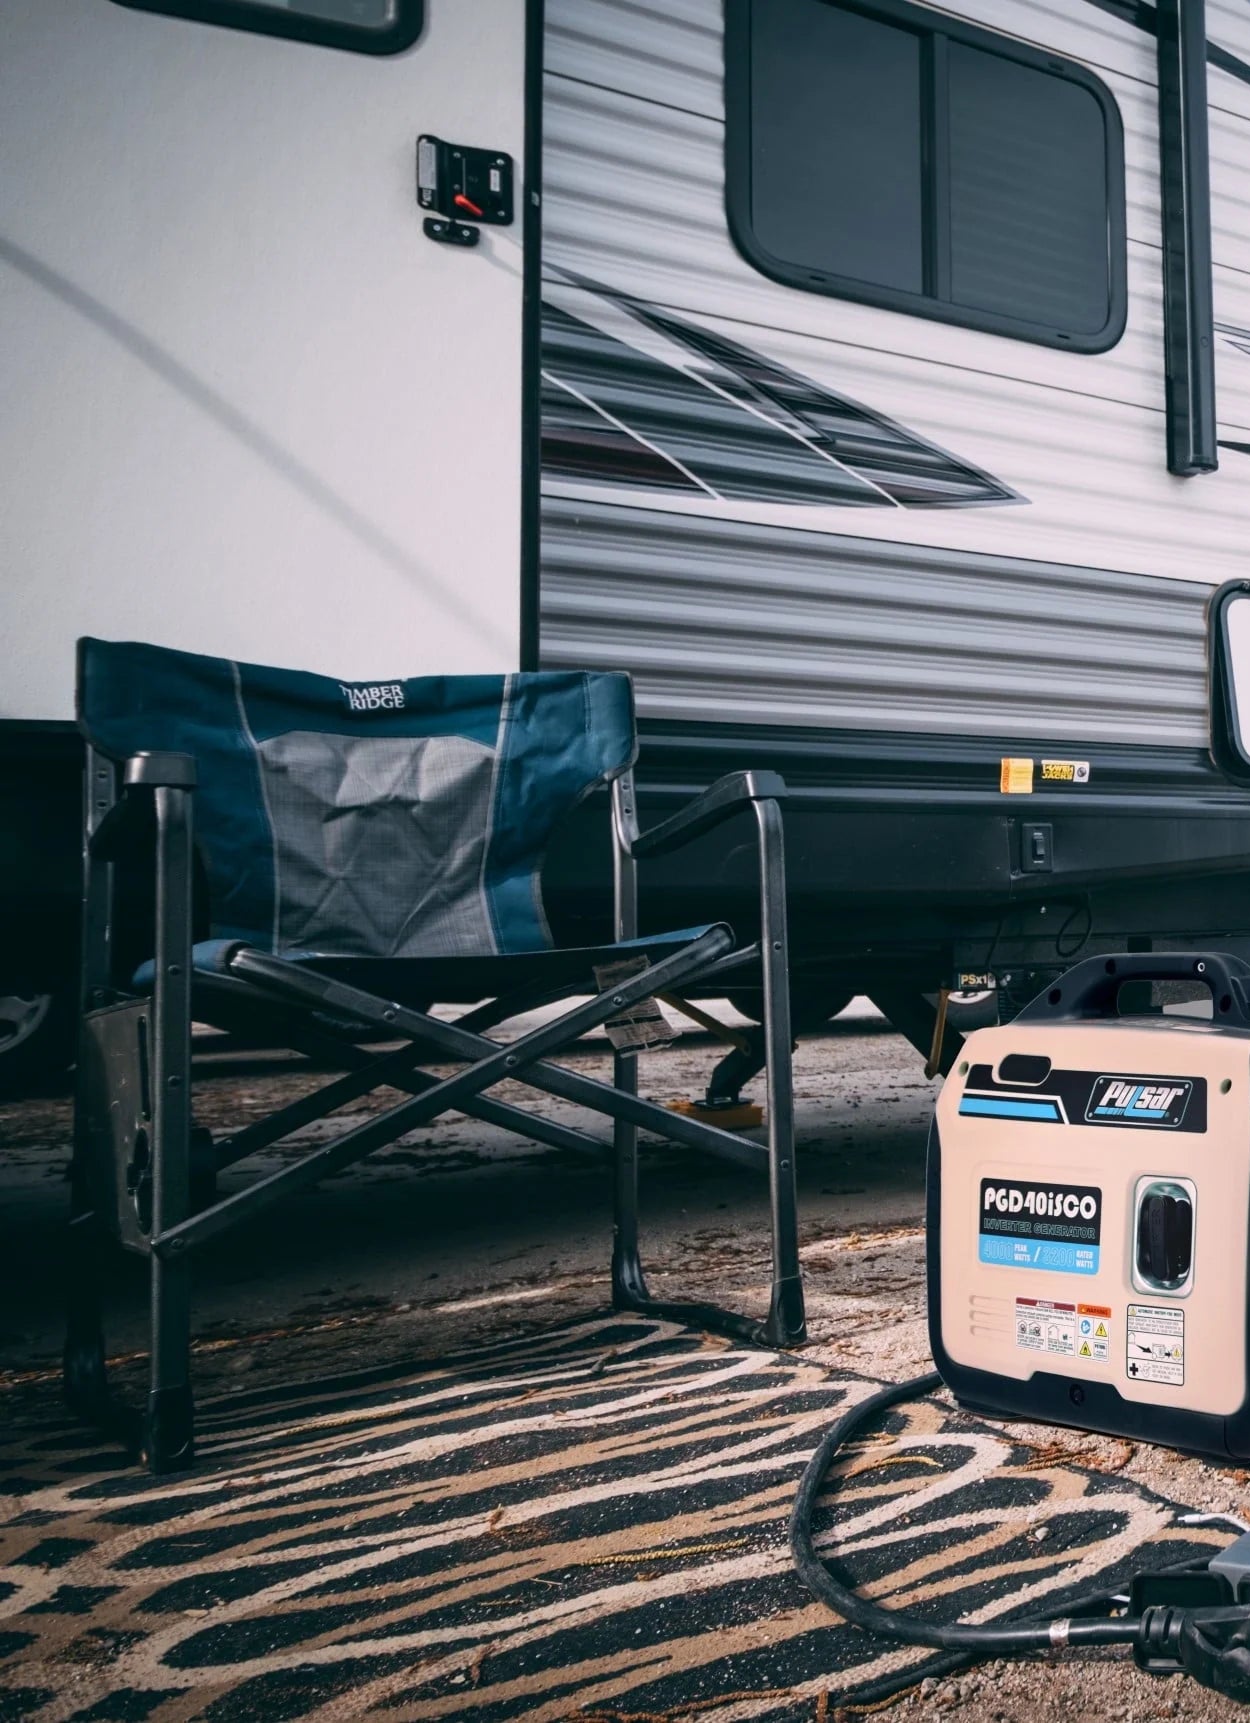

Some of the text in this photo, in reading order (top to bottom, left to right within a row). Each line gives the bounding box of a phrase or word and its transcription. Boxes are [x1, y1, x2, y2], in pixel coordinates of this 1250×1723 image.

[350, 696, 405, 710] RIDGE
[1099, 1081, 1184, 1118] Pulsar
[983, 1218, 1096, 1239] INVERTER GENERATOR
